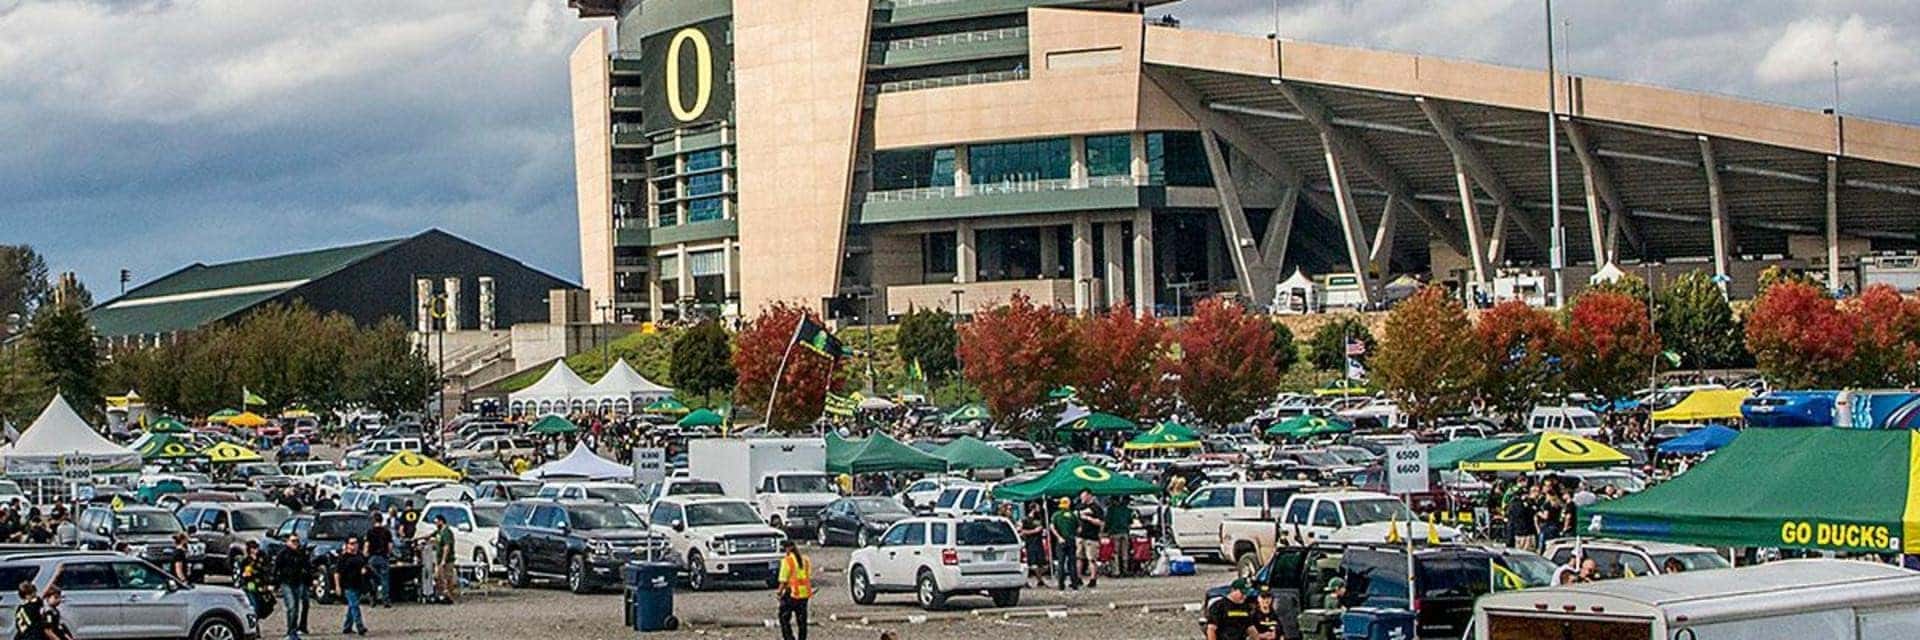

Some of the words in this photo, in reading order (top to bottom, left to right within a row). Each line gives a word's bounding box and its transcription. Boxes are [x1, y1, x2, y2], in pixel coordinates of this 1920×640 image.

[667, 28, 712, 122] O
[1396, 450, 1420, 460] 6500
[65, 457, 90, 466] 6100
[1397, 464, 1421, 473] 6600
[65, 470, 90, 479] 6200
[1781, 521, 1812, 545] GO
[1817, 523, 1889, 549] DUCKS
